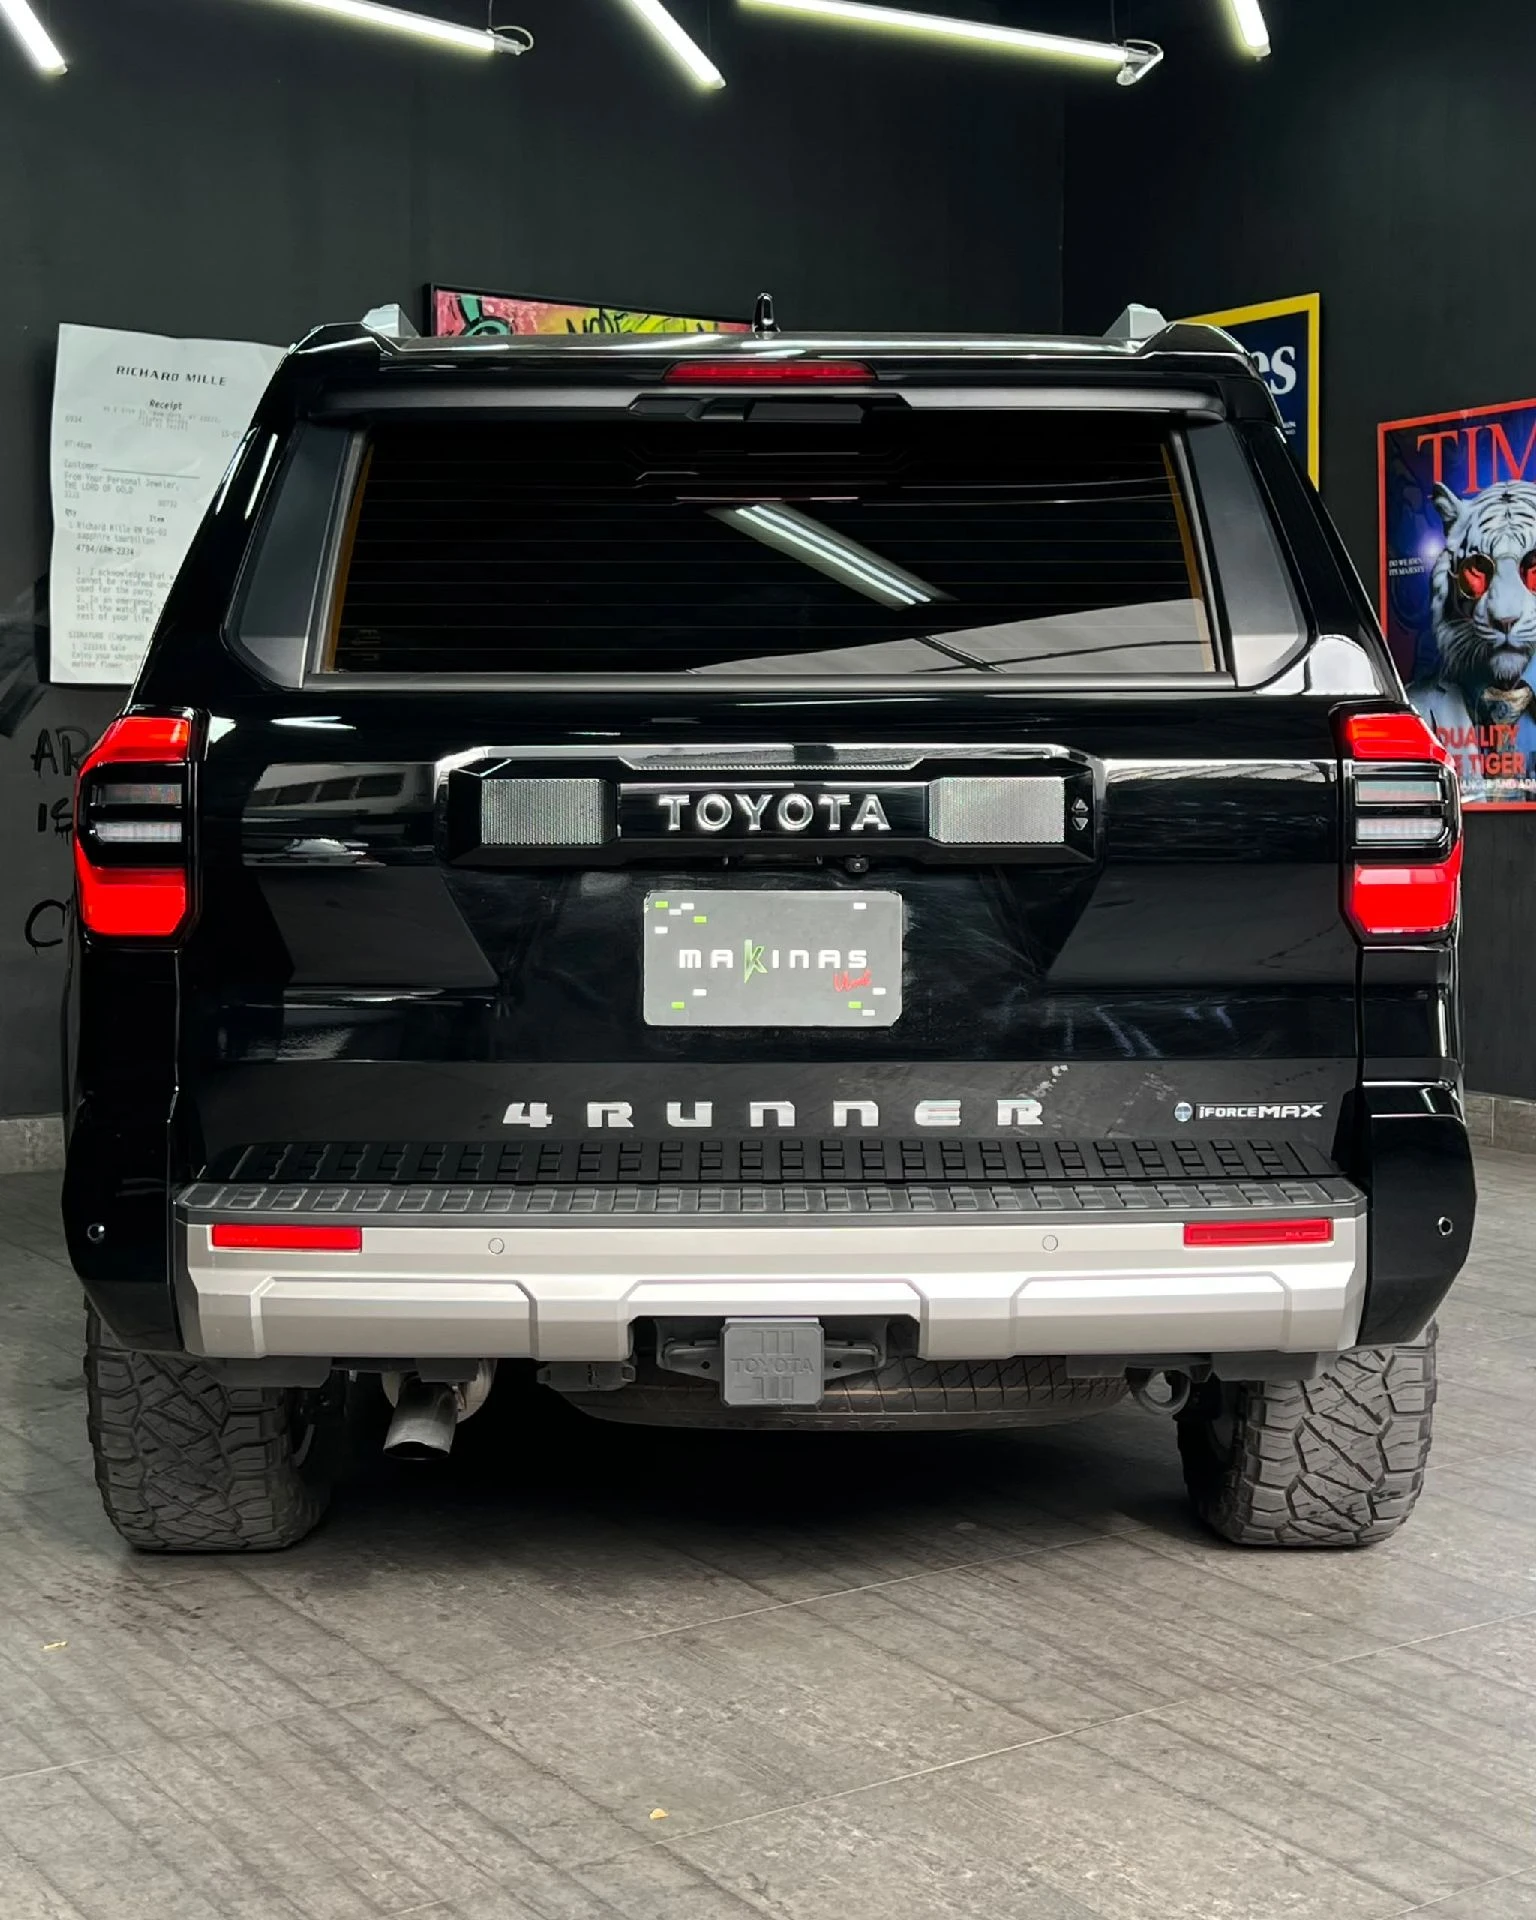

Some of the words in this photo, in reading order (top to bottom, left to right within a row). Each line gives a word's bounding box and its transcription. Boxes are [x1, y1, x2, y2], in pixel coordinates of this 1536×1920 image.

[115, 365, 180, 382] RICHARD
[185, 373, 228, 386] MILLE
[149, 399, 183, 412] Receipt
[64, 459, 98, 469] Customer
[64, 472, 82, 481] From
[85, 473, 102, 482] Your
[107, 475, 141, 486] Personal
[64, 481, 77, 490] THE
[82, 482, 99, 491] LORD
[102, 484, 111, 492] OF
[116, 485, 134, 494] GOLD
[149, 514, 165, 523] Item
[76, 521, 106, 531] Richard
[109, 523, 130, 533] Mille
[76, 532, 110, 542] sapphire
[98, 569, 145, 580] acknowledge
[76, 577, 102, 585] cannot
[107, 577, 116, 585] be
[99, 586, 111, 594] for
[116, 586, 129, 594] the
[98, 613, 107, 621] of
[1468, 751, 1525, 775] TIGER
[657, 792, 892, 831] TOYOTA
[730, 1357, 814, 1375] TOYOTA
